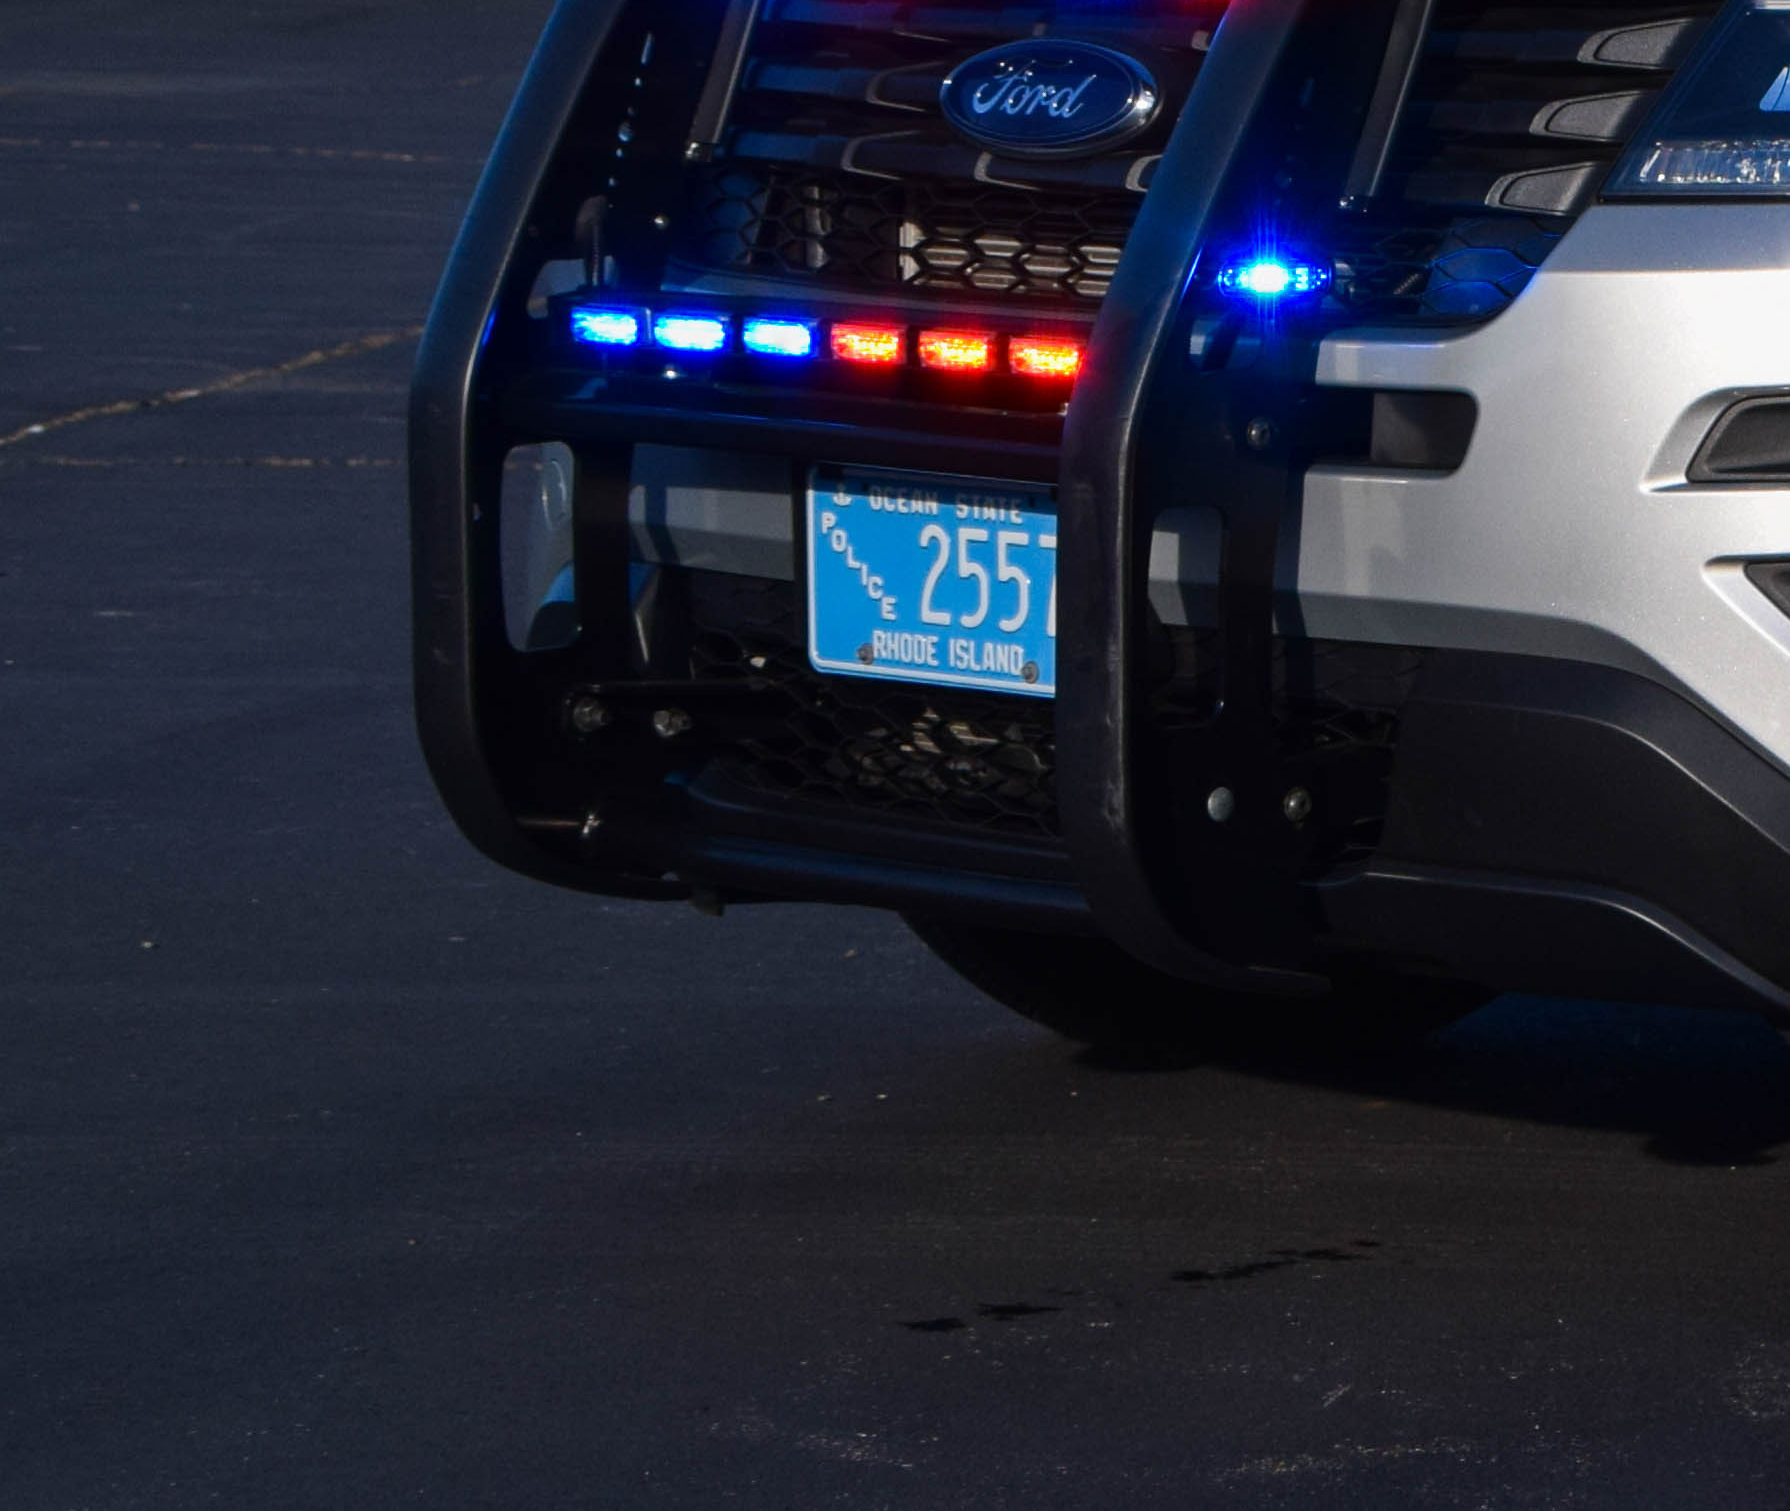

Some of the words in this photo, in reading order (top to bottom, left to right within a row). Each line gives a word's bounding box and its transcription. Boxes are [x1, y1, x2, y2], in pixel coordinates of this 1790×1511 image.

[972, 71, 1097, 119] Ford
[867, 485, 939, 516] OCEAN
[955, 493, 1024, 525] STATE
[820, 511, 897, 621] POLICE
[872, 629, 940, 667] RHODE
[949, 639, 1024, 677] ISLAND
